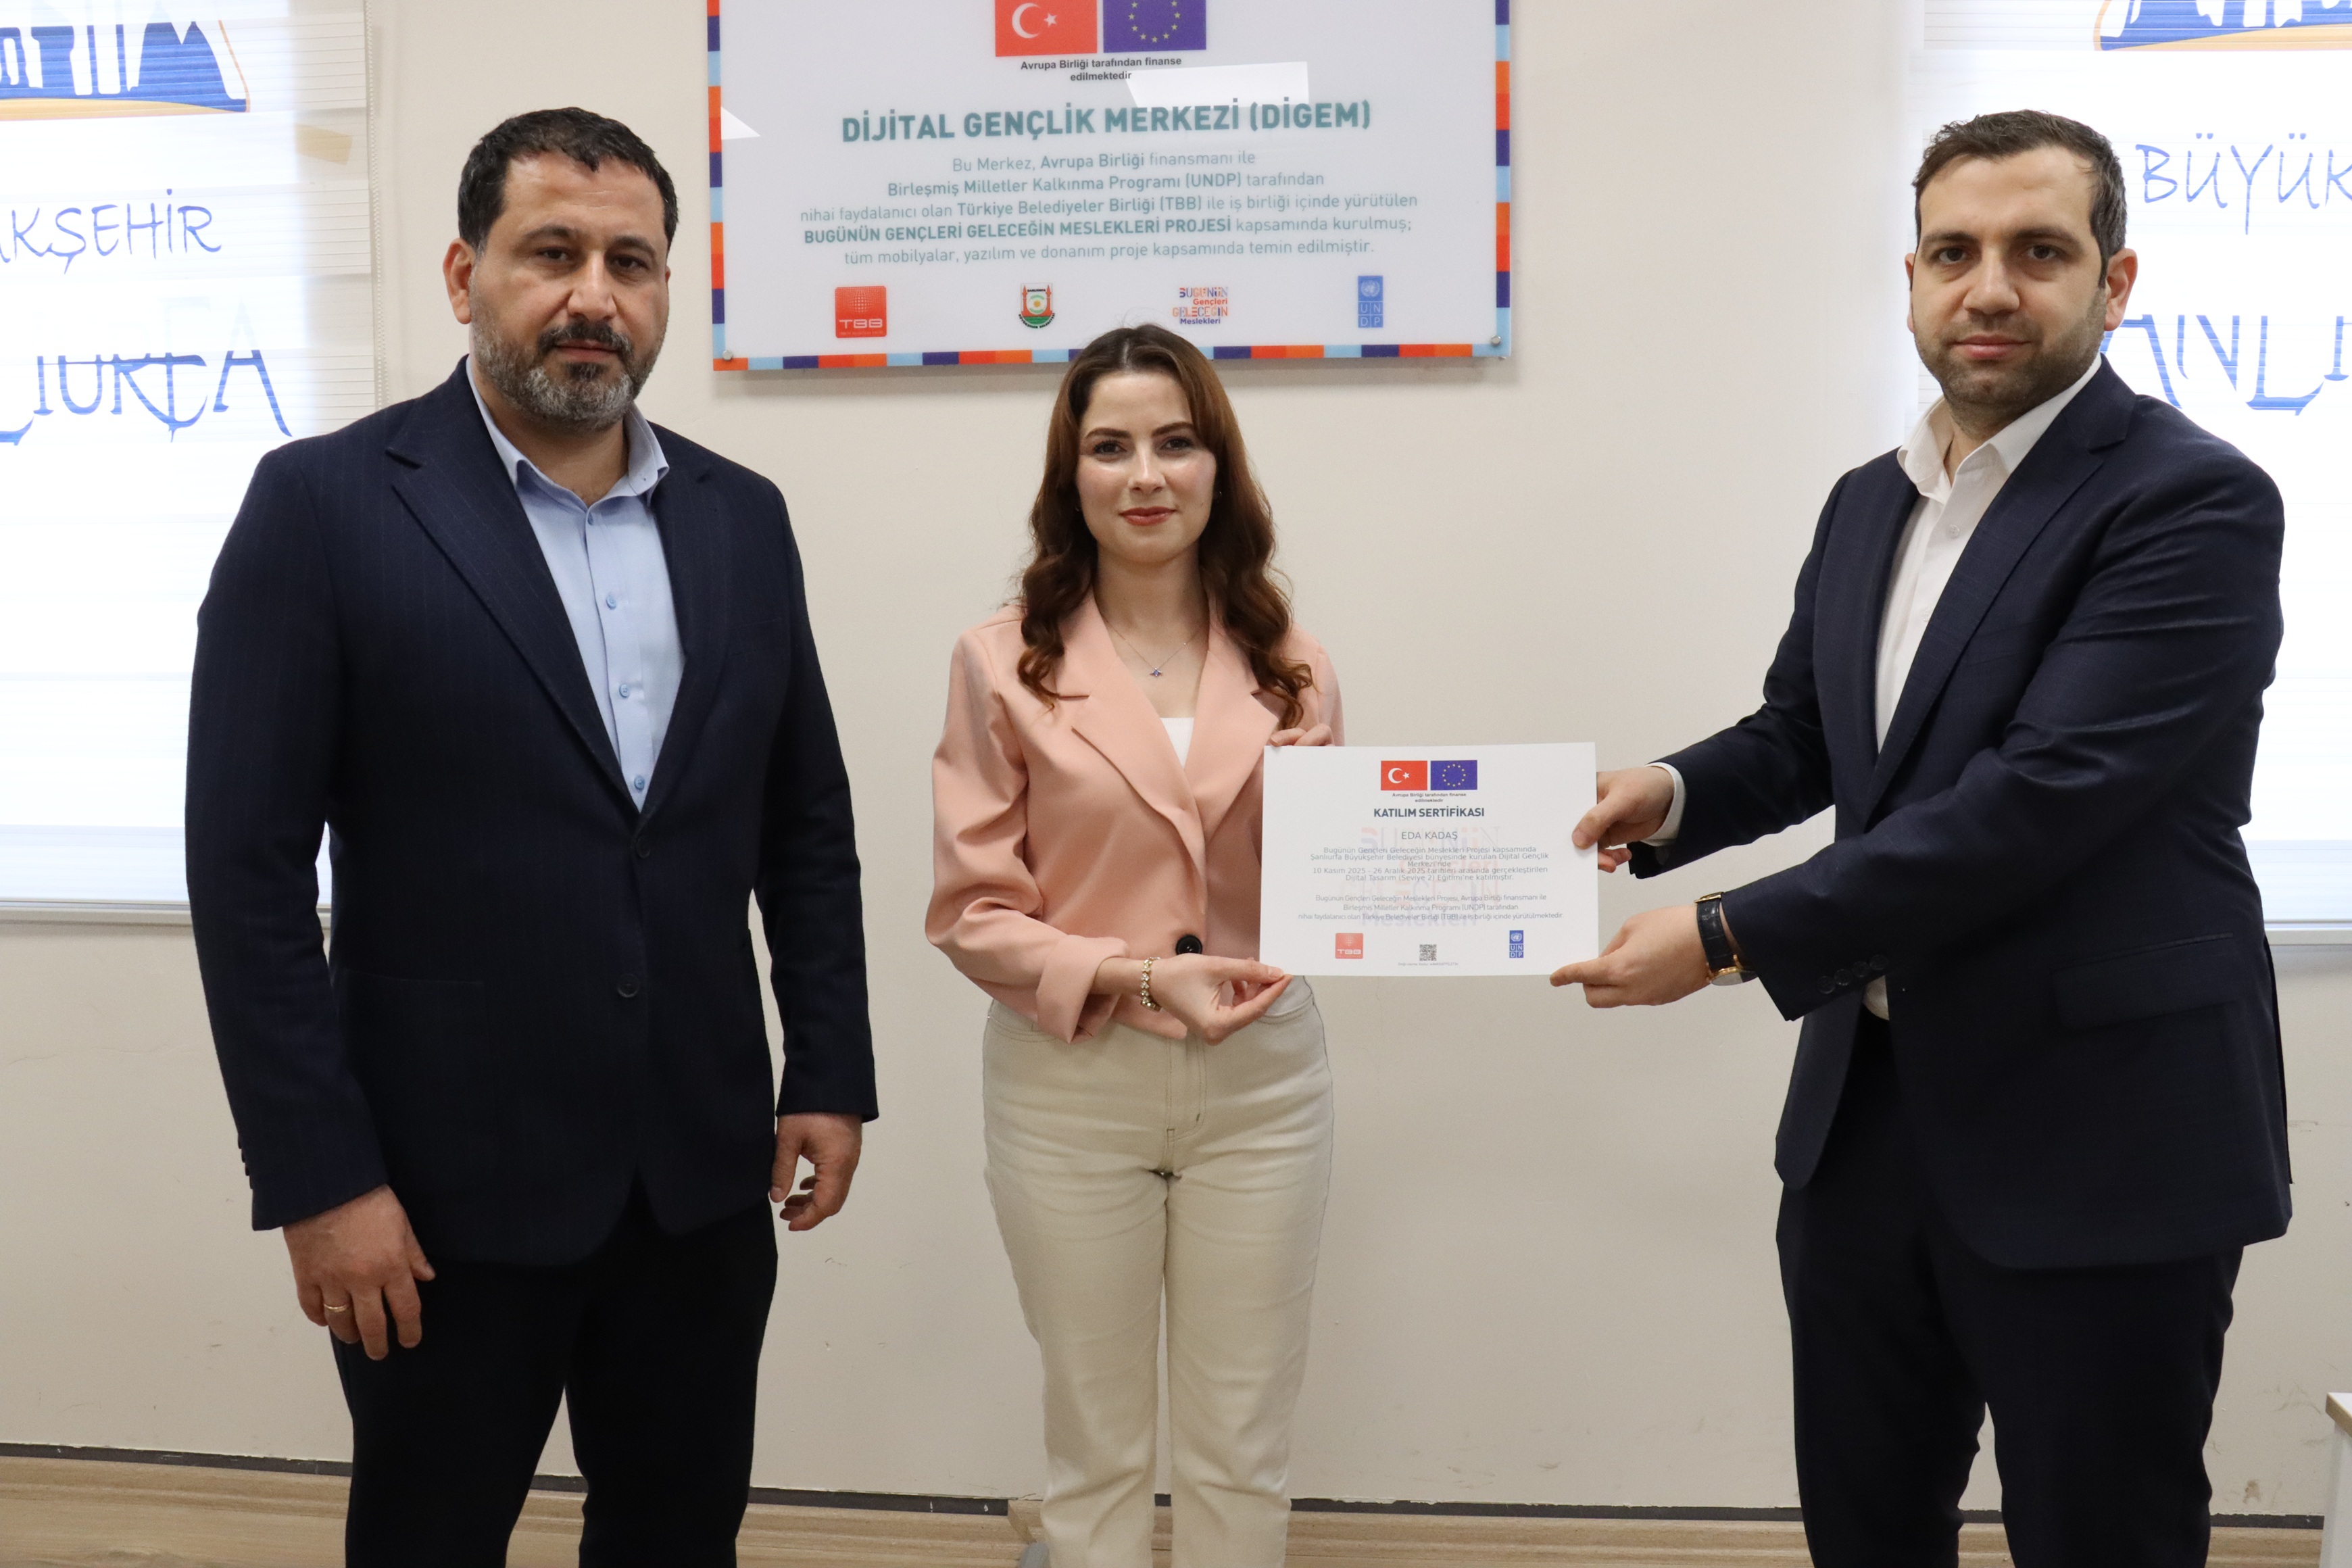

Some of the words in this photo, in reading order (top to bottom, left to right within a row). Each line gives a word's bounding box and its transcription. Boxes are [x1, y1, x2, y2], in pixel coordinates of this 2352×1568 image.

[1021, 61, 1056, 71] Avrupa
[1060, 59, 1088, 69] Birliği
[1092, 57, 1142, 67] tarafından
[1145, 57, 1181, 66] finanse
[1071, 72, 1131, 81] edilmektedir
[843, 109, 954, 142] DİJİTAL
[964, 103, 1096, 140] GENÇLİK
[1104, 98, 1239, 132] MERKEZİ
[1250, 97, 1371, 132] (DİGEM)
[953, 158, 971, 172] Bu
[977, 157, 1035, 171] Merkez,
[1040, 155, 1094, 171] Avrupa
[1099, 153, 1144, 169] Birliği
[1150, 152, 1232, 165] finansmanı
[1238, 151, 1256, 164] ile
[888, 182, 959, 197] Birleşmiş
[964, 179, 1028, 194] Milletler
[1033, 177, 1103, 191] Kalkınma
[1109, 176, 1180, 191] Programı
[1186, 172, 1241, 187] (UNDP)
[1246, 172, 1323, 186] tarafından
[2135, 132, 2352, 235] BÜYÜK
[801, 207, 834, 222] nihai
[839, 207, 916, 222] faydalanıcı
[922, 204, 952, 218] olan
[957, 201, 1013, 218] Türkiye
[1019, 200, 1103, 216] Belediyeler
[1109, 198, 1154, 214] Birliği
[1160, 196, 1201, 211] (TBB)
[1208, 196, 1224, 209] ile
[1230, 196, 1242, 211] iş
[1247, 194, 1290, 211] birliği
[1296, 194, 1339, 210] içinde
[1345, 193, 1417, 210] yürütülen
[805, 228, 879, 243] BUGÜNÜN
[885, 222, 962, 243] GENÇLERİ
[967, 220, 1054, 239] GELECEĞİN
[1060, 215, 1160, 235] MESLEKLERİ
[1166, 216, 1231, 232] PROJESİ
[1236, 217, 1327, 233] kapsamında
[1333, 216, 1411, 232] kurulmuş;
[845, 252, 873, 264] tüm
[878, 251, 959, 264] mobilyalar,
[964, 248, 1014, 263] yazılım
[1020, 248, 1035, 258] ve
[1041, 246, 1104, 258] donanım
[1110, 245, 1148, 260] proje
[1154, 241, 1244, 258] kapsamında
[1249, 241, 1292, 254] temin
[1298, 240, 1373, 255] edilmiştir.
[839, 318, 883, 328] TBB
[1374, 808, 1416, 817] KATILIM
[1419, 806, 1484, 816] SERTİFİKASI
[1425, 831, 1458, 840] KADAŞ
